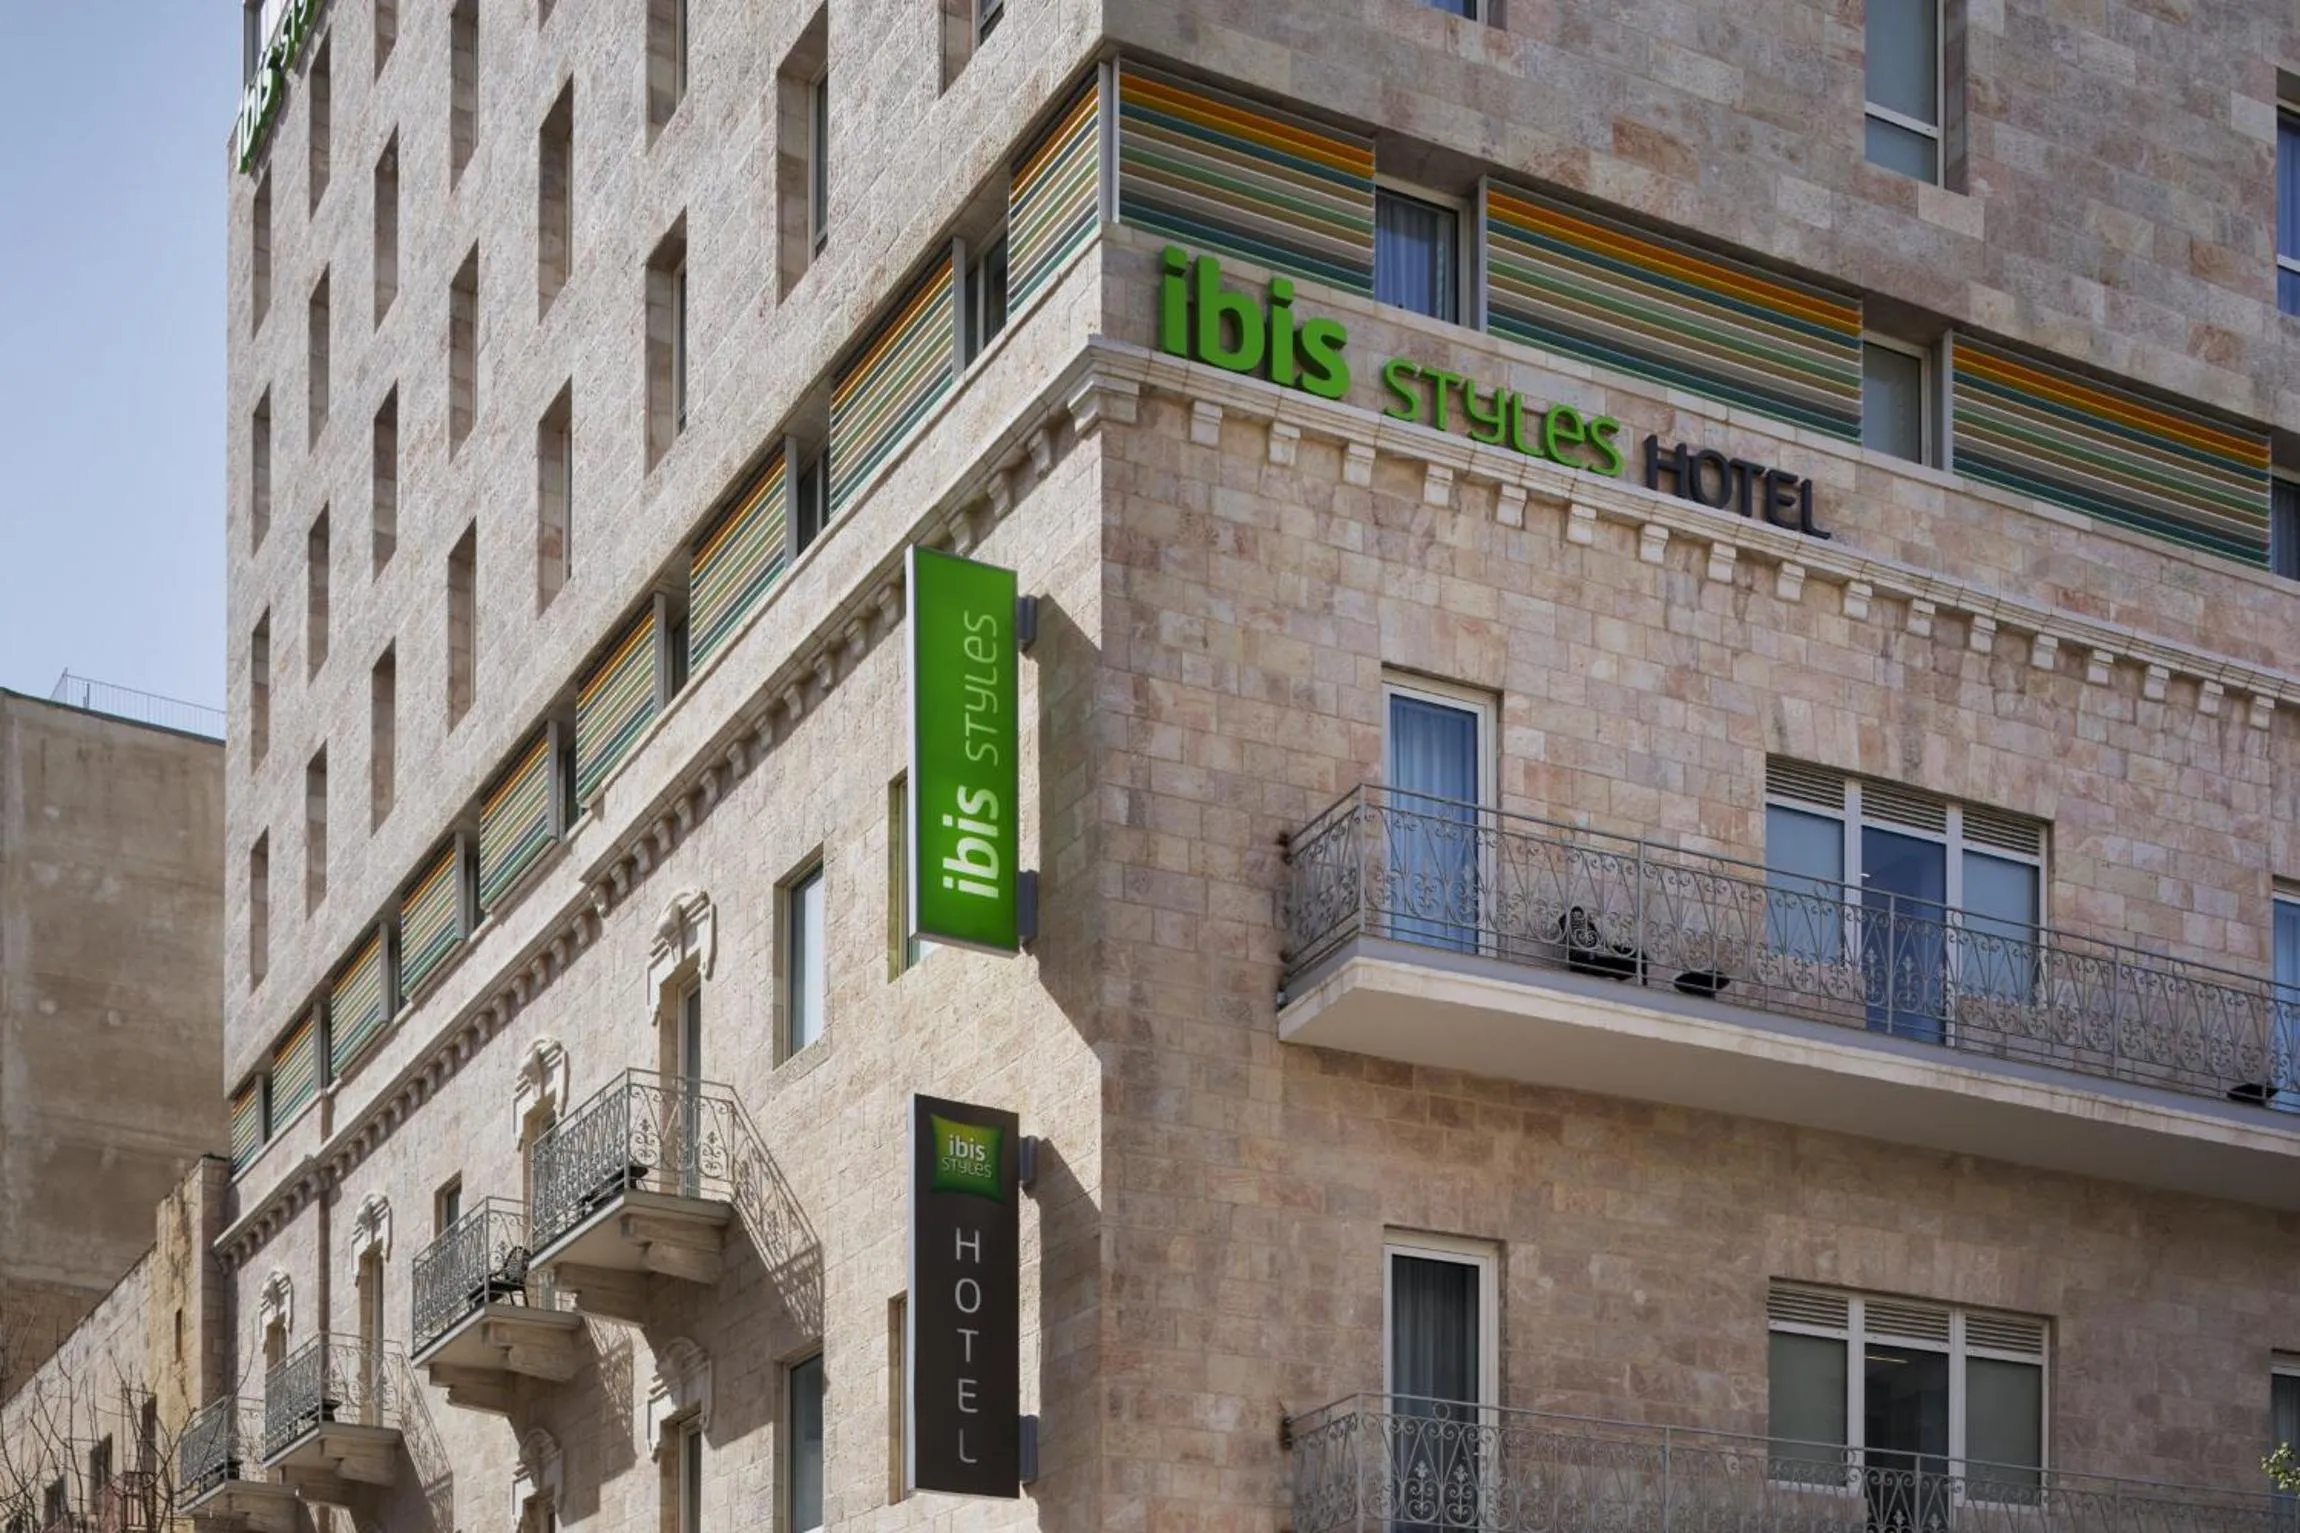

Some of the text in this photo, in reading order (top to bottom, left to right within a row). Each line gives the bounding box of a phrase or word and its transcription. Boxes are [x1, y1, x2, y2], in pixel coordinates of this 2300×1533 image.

[1159, 245, 1351, 400] ibis
[1643, 434, 1831, 541] HOTEL
[942, 785, 999, 899] ibis
[948, 1133, 986, 1161] ibis
[954, 1227, 982, 1464] HOTEL
